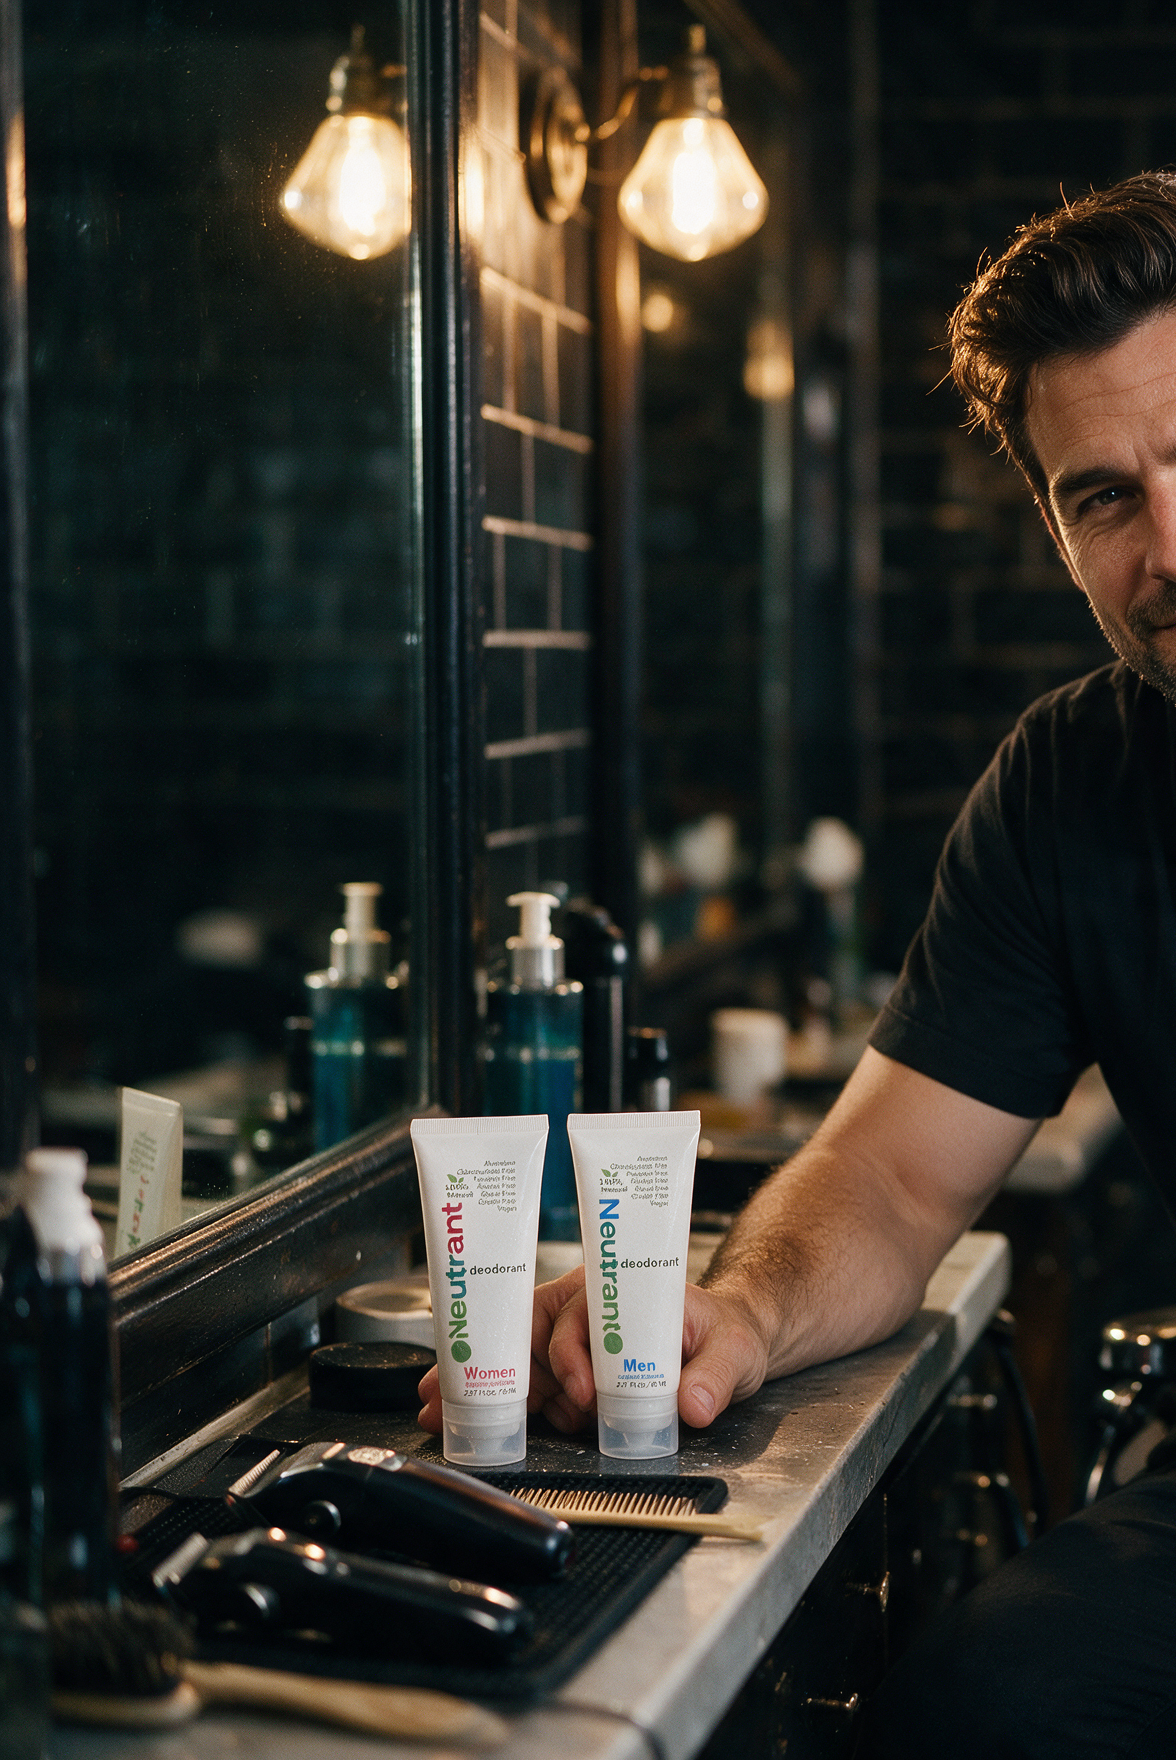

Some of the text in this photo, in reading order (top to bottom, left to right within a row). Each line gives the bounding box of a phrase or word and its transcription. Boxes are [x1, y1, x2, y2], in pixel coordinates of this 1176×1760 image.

[469, 1263, 527, 1275] deodorant
[598, 1199, 622, 1332] Neutrant
[620, 1257, 679, 1269] deodorant
[441, 1202, 469, 1339] Neutrant
[623, 1359, 656, 1372] Men
[463, 1366, 516, 1380] Women
